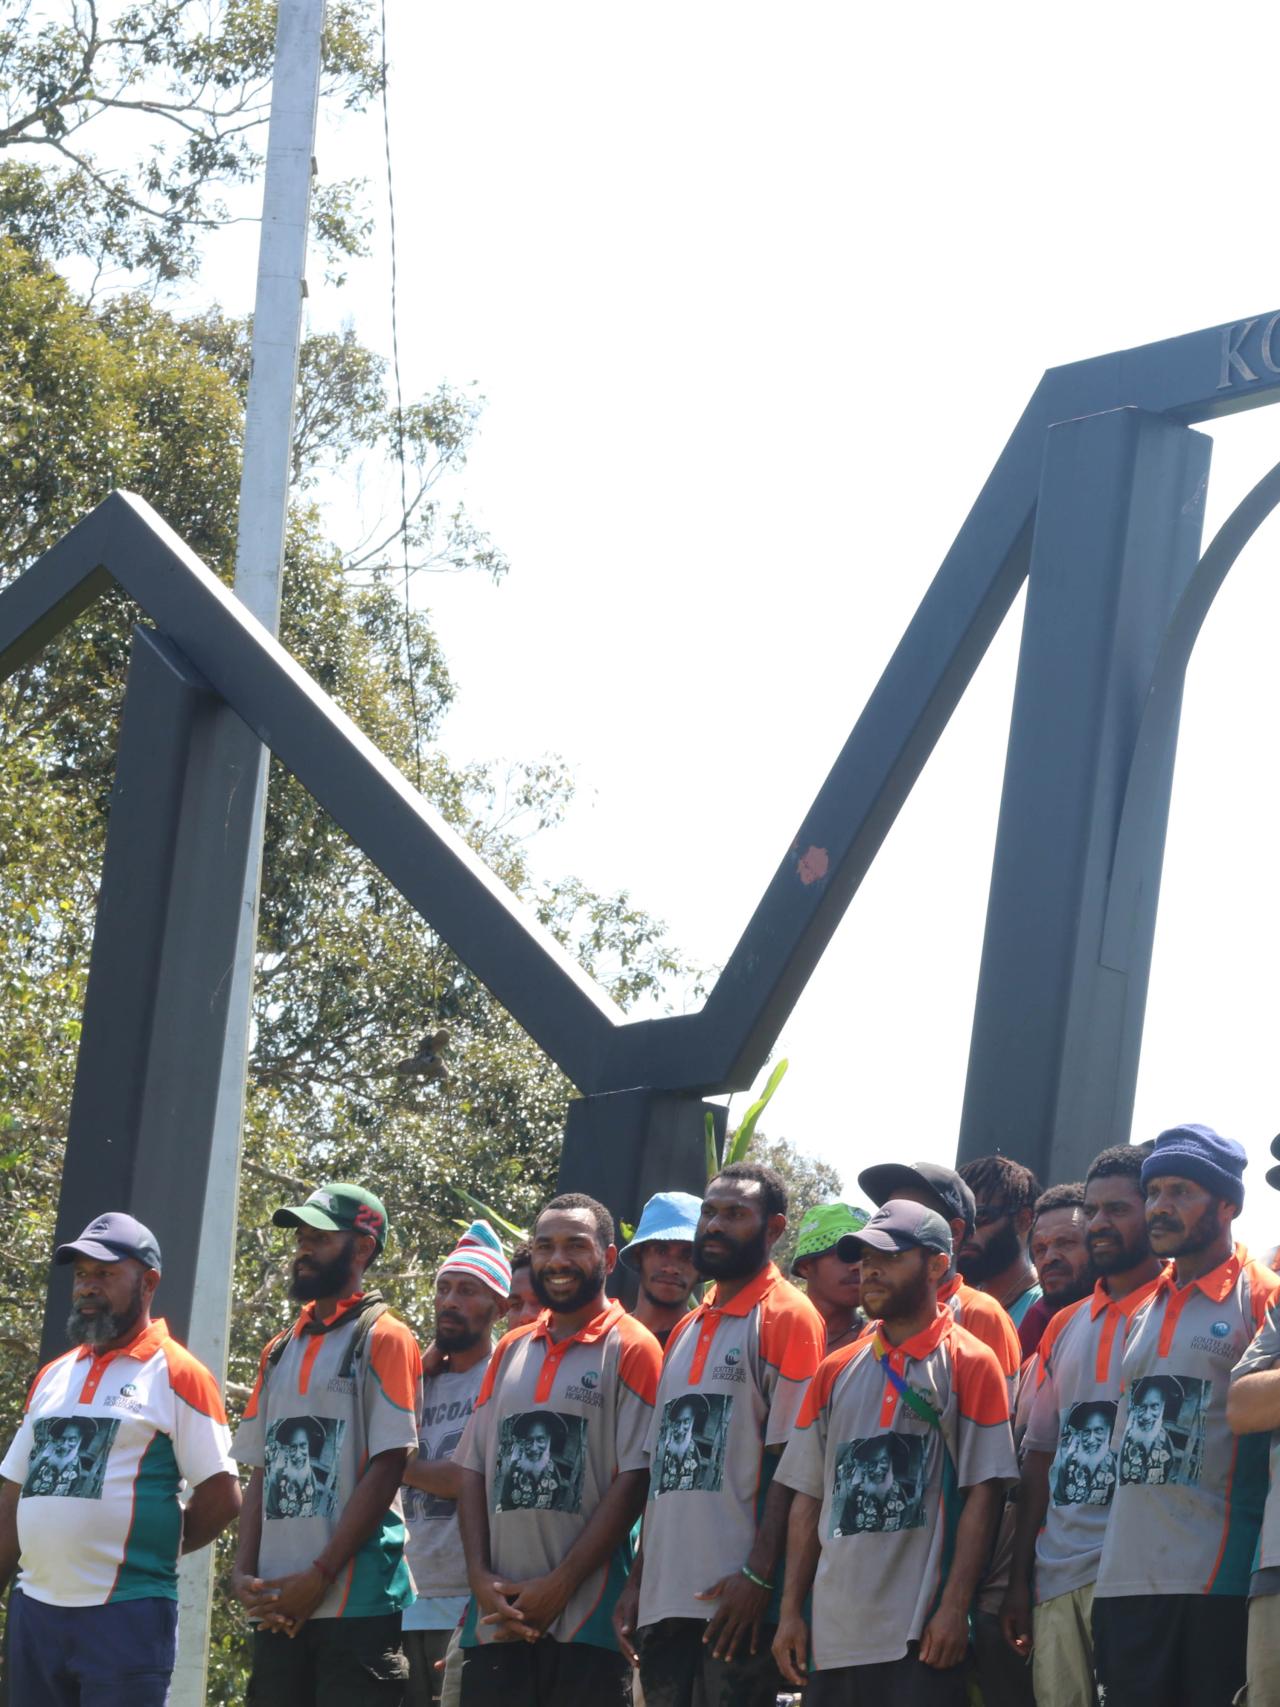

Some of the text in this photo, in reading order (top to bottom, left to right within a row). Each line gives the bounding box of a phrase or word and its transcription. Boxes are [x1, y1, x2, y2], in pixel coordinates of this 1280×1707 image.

[1192, 1335, 1221, 1347] SOUTH
[712, 1366, 734, 1374] SOUTH
[566, 1384, 592, 1397] SOUTH
